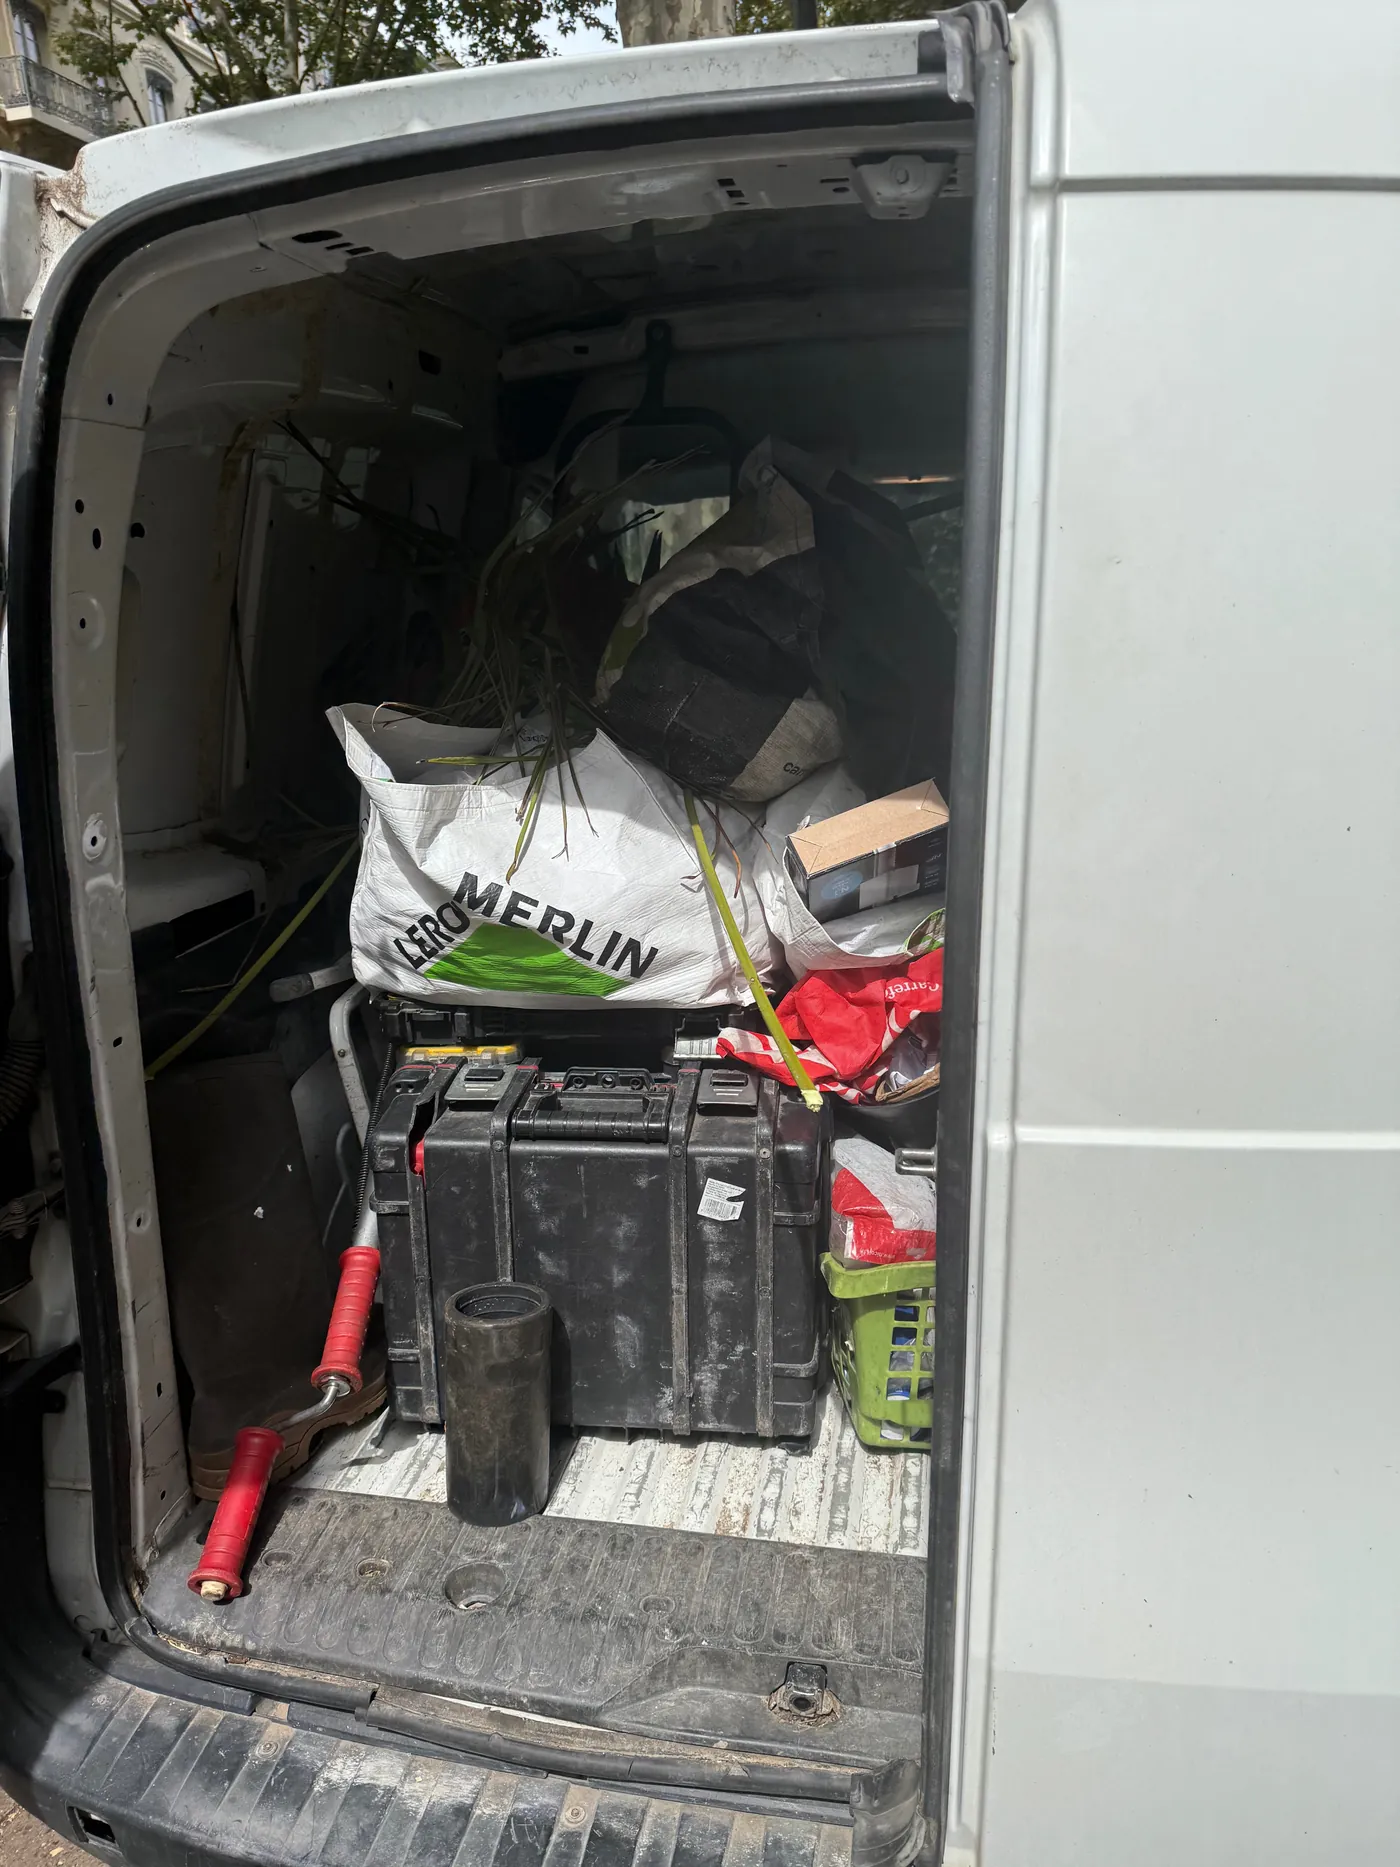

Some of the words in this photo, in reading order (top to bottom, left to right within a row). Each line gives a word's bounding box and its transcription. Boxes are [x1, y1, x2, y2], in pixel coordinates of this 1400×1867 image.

[393, 901, 470, 970] LERO
[452, 871, 659, 979] MERLIN
[885, 981, 940, 999] Carref
